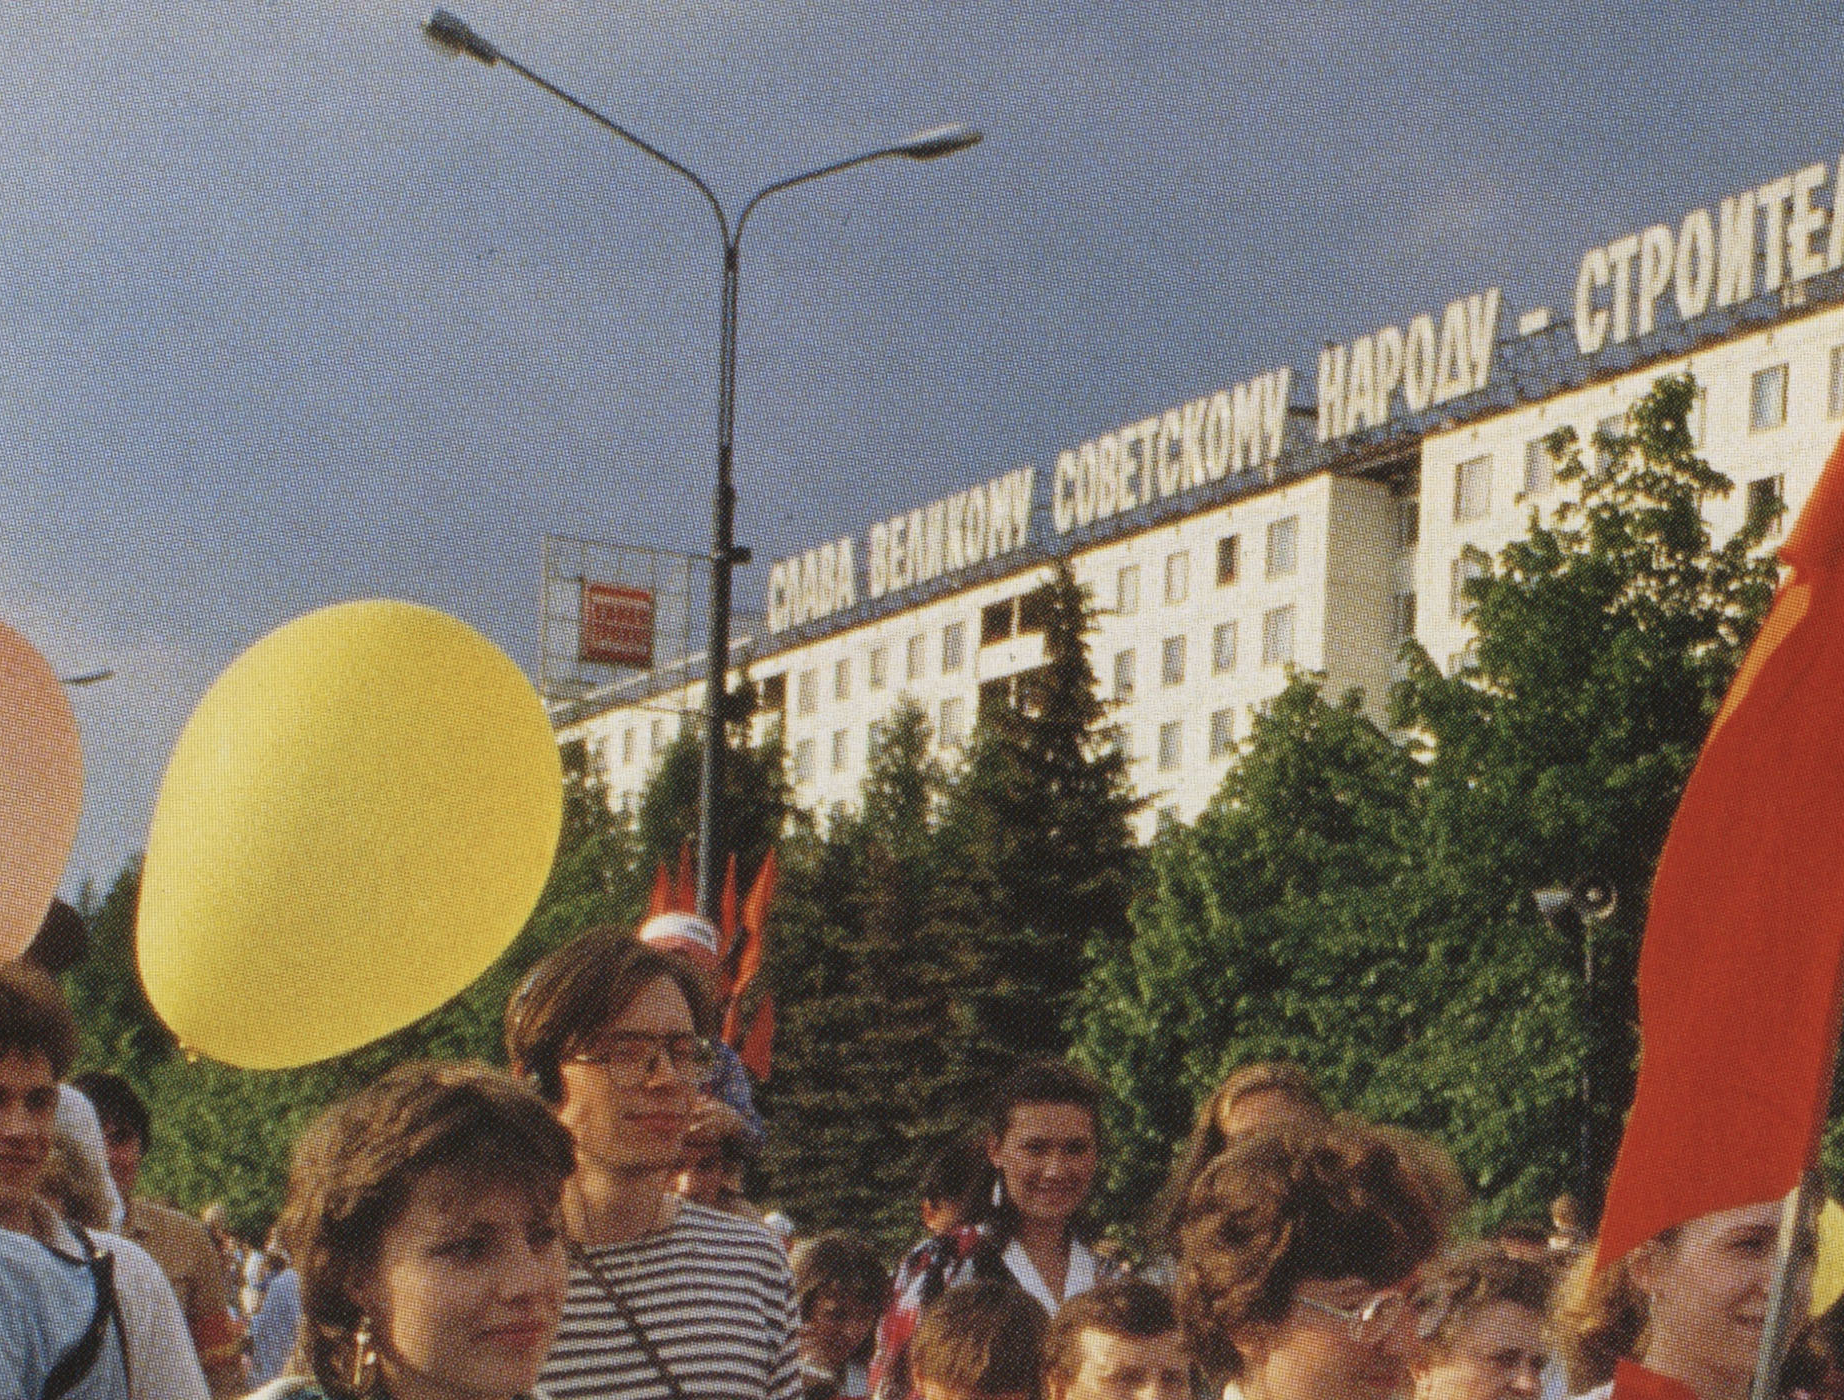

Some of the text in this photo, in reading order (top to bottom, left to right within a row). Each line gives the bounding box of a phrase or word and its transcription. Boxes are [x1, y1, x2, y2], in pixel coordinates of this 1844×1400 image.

[767, 536, 857, 634] СЛАВА
[867, 467, 1035, 599] ВЕЛИКОМУ
[1054, 365, 1291, 536] СОВЕТСКОМУ
[1316, 286, 1502, 443] НАРОДУ
